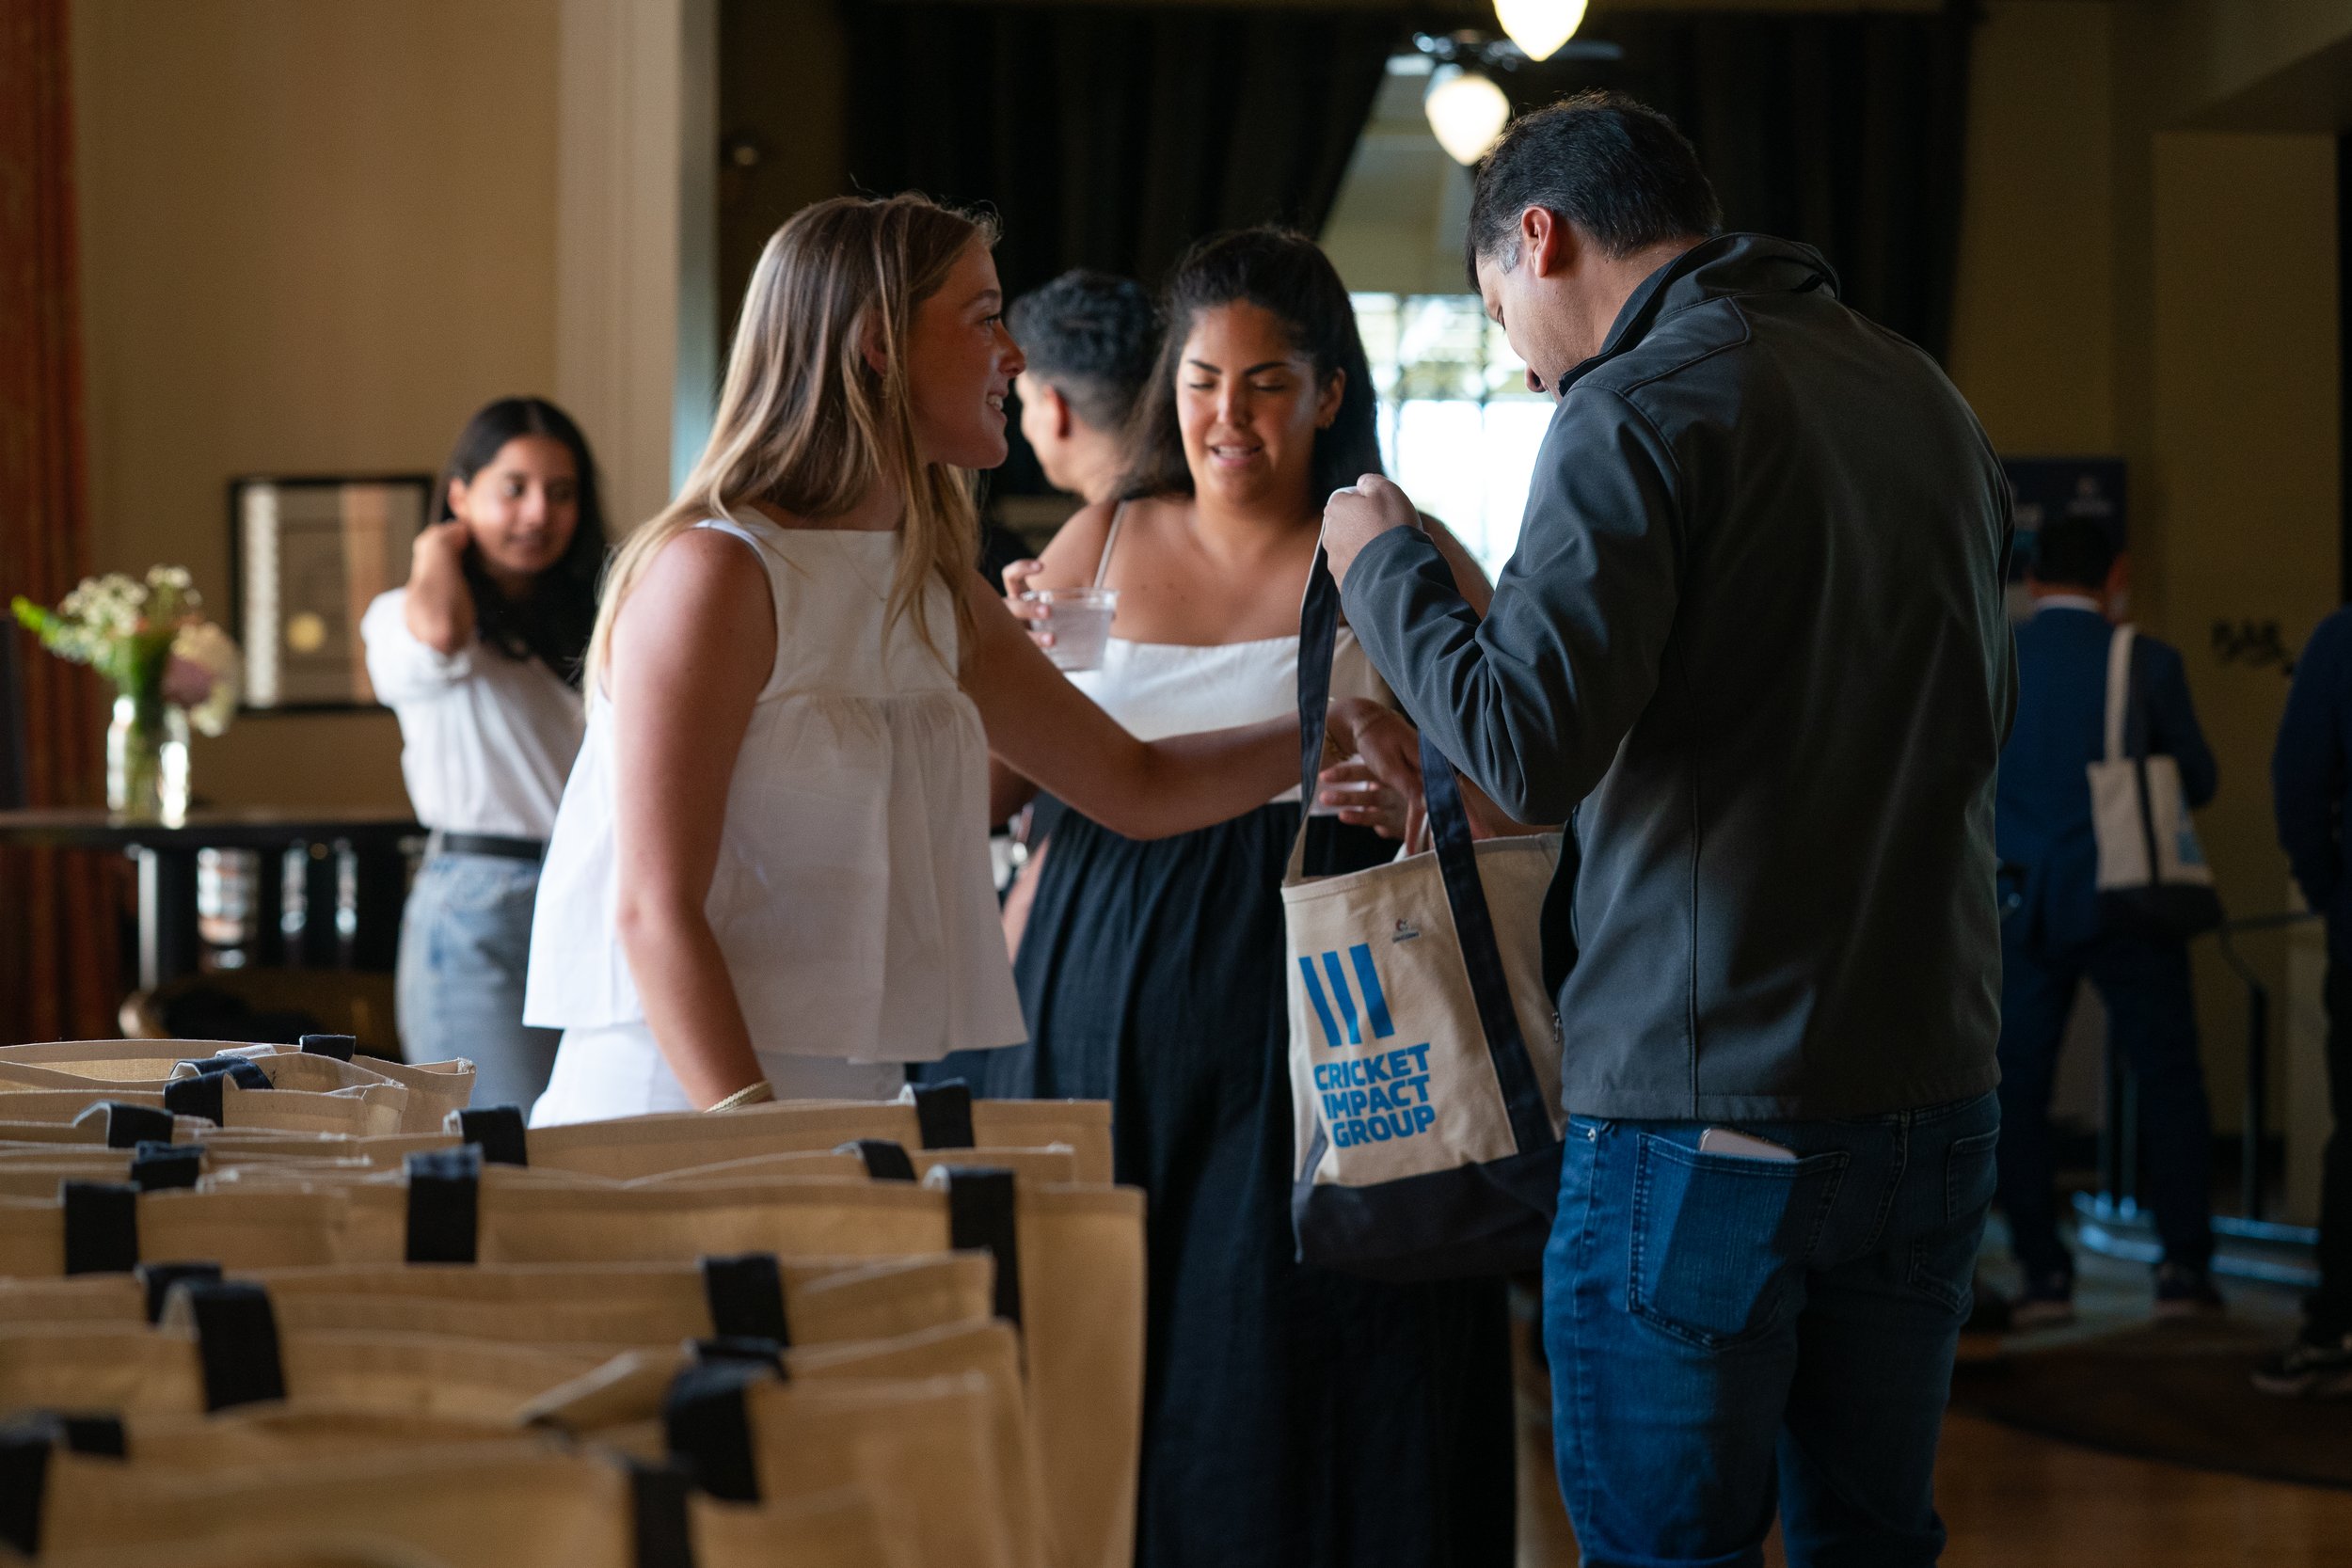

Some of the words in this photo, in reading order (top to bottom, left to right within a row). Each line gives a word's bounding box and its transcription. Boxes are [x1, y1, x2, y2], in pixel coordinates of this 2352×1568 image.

[1314, 1043, 1430, 1091] CRICKET
[1322, 1074, 1430, 1119] IMPACT
[1332, 1105, 1436, 1148] GROUP
